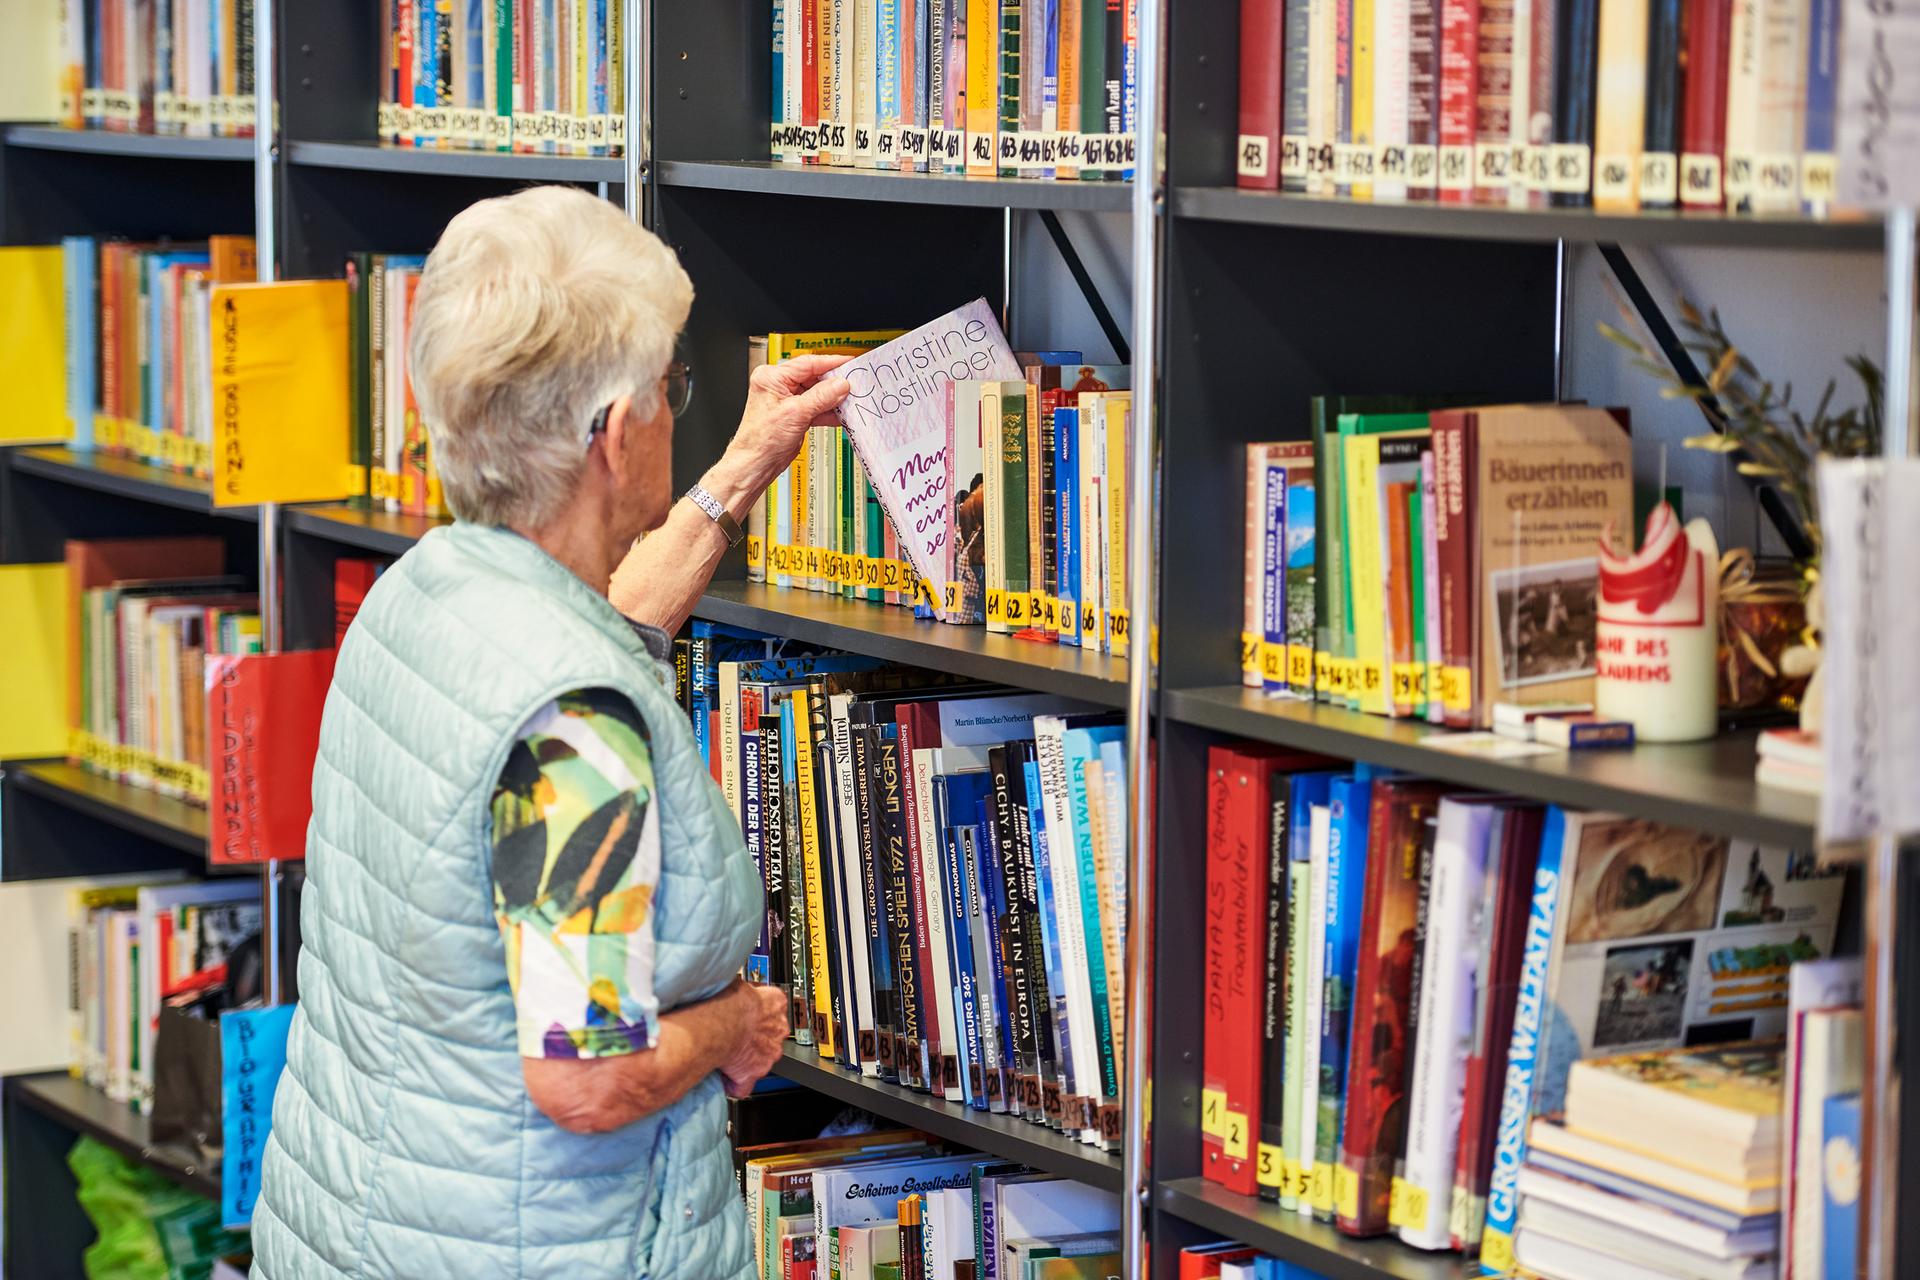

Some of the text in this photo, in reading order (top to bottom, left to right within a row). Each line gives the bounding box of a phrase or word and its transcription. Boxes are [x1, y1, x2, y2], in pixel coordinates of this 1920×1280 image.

[822, 6, 831, 60] DIE NEUE
[933, 7, 943, 118] DIE MADONNA IN DER
[822, 76, 831, 111] KREIN
[1105, 80, 1121, 115] Azadi
[855, 129, 869, 150] 156
[878, 133, 893, 153] 157
[945, 134, 959, 158] 161
[973, 135, 991, 160] 162
[1000, 136, 1017, 158] 163
[1019, 139, 1040, 162] 164
[1057, 135, 1080, 158] 166
[1103, 139, 1123, 163] 168
[844, 318, 988, 398] Christine
[855, 344, 999, 426] Nöstlinger
[1489, 457, 1626, 484] Bäuerinnen
[1505, 486, 1608, 512] erzählen
[790, 550, 804, 571] 43
[1265, 470, 1278, 632] SONNE UND SCHILD
[867, 563, 878, 584] 50
[884, 564, 898, 586] 52
[987, 594, 999, 615] 61
[1006, 598, 1022, 618] 62
[1061, 606, 1071, 628] 65
[1082, 608, 1095, 630] 66
[692, 639, 705, 693] Karibik
[1265, 653, 1279, 675] 82
[1292, 655, 1306, 677] 83
[1634, 638, 1668, 657] DES
[954, 717, 973, 727] Martin
[832, 716, 853, 806] SIEGERT Südtirol
[855, 736, 865, 766] WELT
[746, 742, 759, 829] CHRONIK DER
[858, 768, 869, 819] UNSERER
[882, 744, 900, 813] LINGEN
[766, 728, 783, 893] WELTGESCHICHTE
[798, 739, 817, 894] DER MENSCHHEIT
[995, 773, 1009, 827] CICHY
[861, 820, 873, 860] RÄTSEL
[1018, 805, 1030, 846] Länder
[1271, 800, 1285, 884] Weltwunder
[889, 835, 904, 874] 1972
[917, 763, 942, 934] Deutschland Allemagne Germany
[1023, 846, 1034, 867] und
[1038, 830, 1050, 868] BRASIL
[1079, 832, 1096, 878] DEN
[866, 862, 877, 916] GROSSEN
[949, 842, 963, 918] CITY PANORAMAS
[964, 839, 979, 915] CITY PANORAMAS
[1002, 840, 1020, 933] BAUKUNST
[1026, 869, 1037, 905] Völker
[1327, 826, 1342, 926] SCHOTTLAND
[885, 889, 895, 922] ROM
[894, 877, 910, 928] SPIELE
[1083, 882, 1100, 920] MIT
[1228, 836, 1248, 999] Trachtenbilder
[870, 918, 879, 938] DIE
[1011, 942, 1023, 964] IN
[1209, 880, 1227, 1021] DAMALS
[980, 994, 993, 1034] BERLIN
[1015, 969, 1031, 1039] EUROPA
[964, 1001, 979, 1064] HAMBURG
[1010, 1012, 1021, 1053] JANEIRO
[1488, 867, 1558, 1222] GROSSER WELTATLAS
[1105, 1057, 1116, 1096] Cynthia
[1206, 1099, 1216, 1124] 1
[1229, 1121, 1240, 1145] 2
[1258, 1151, 1271, 1175] 3
[845, 1177, 899, 1200] Geheime
[1299, 1174, 1312, 1196] 5
[983, 1200, 993, 1280] Katzen
